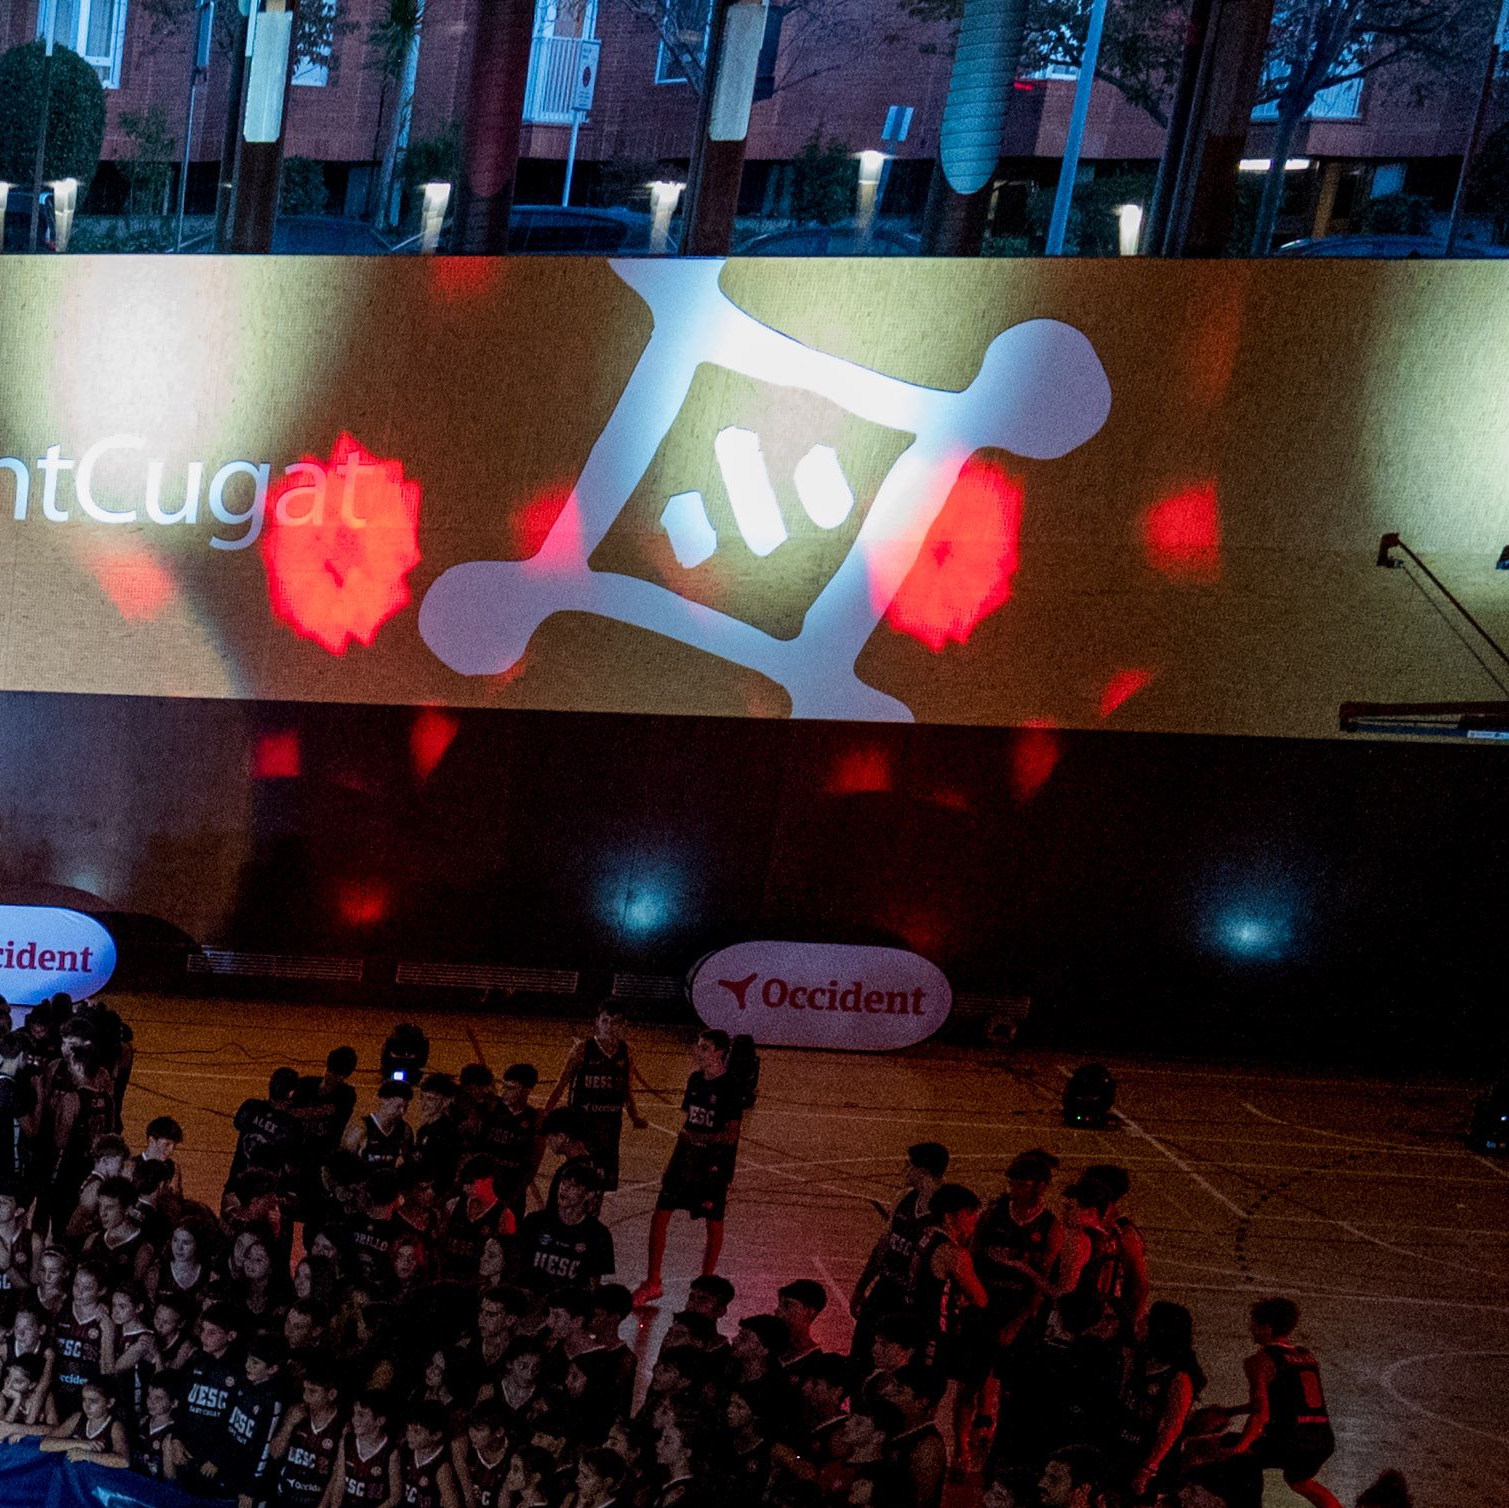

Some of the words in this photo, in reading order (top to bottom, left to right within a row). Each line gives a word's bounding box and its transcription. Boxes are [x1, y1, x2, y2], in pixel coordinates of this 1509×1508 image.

[762, 978, 926, 1015] Occident
[533, 1251, 581, 1279] UESC
[188, 1383, 227, 1409] UESC
